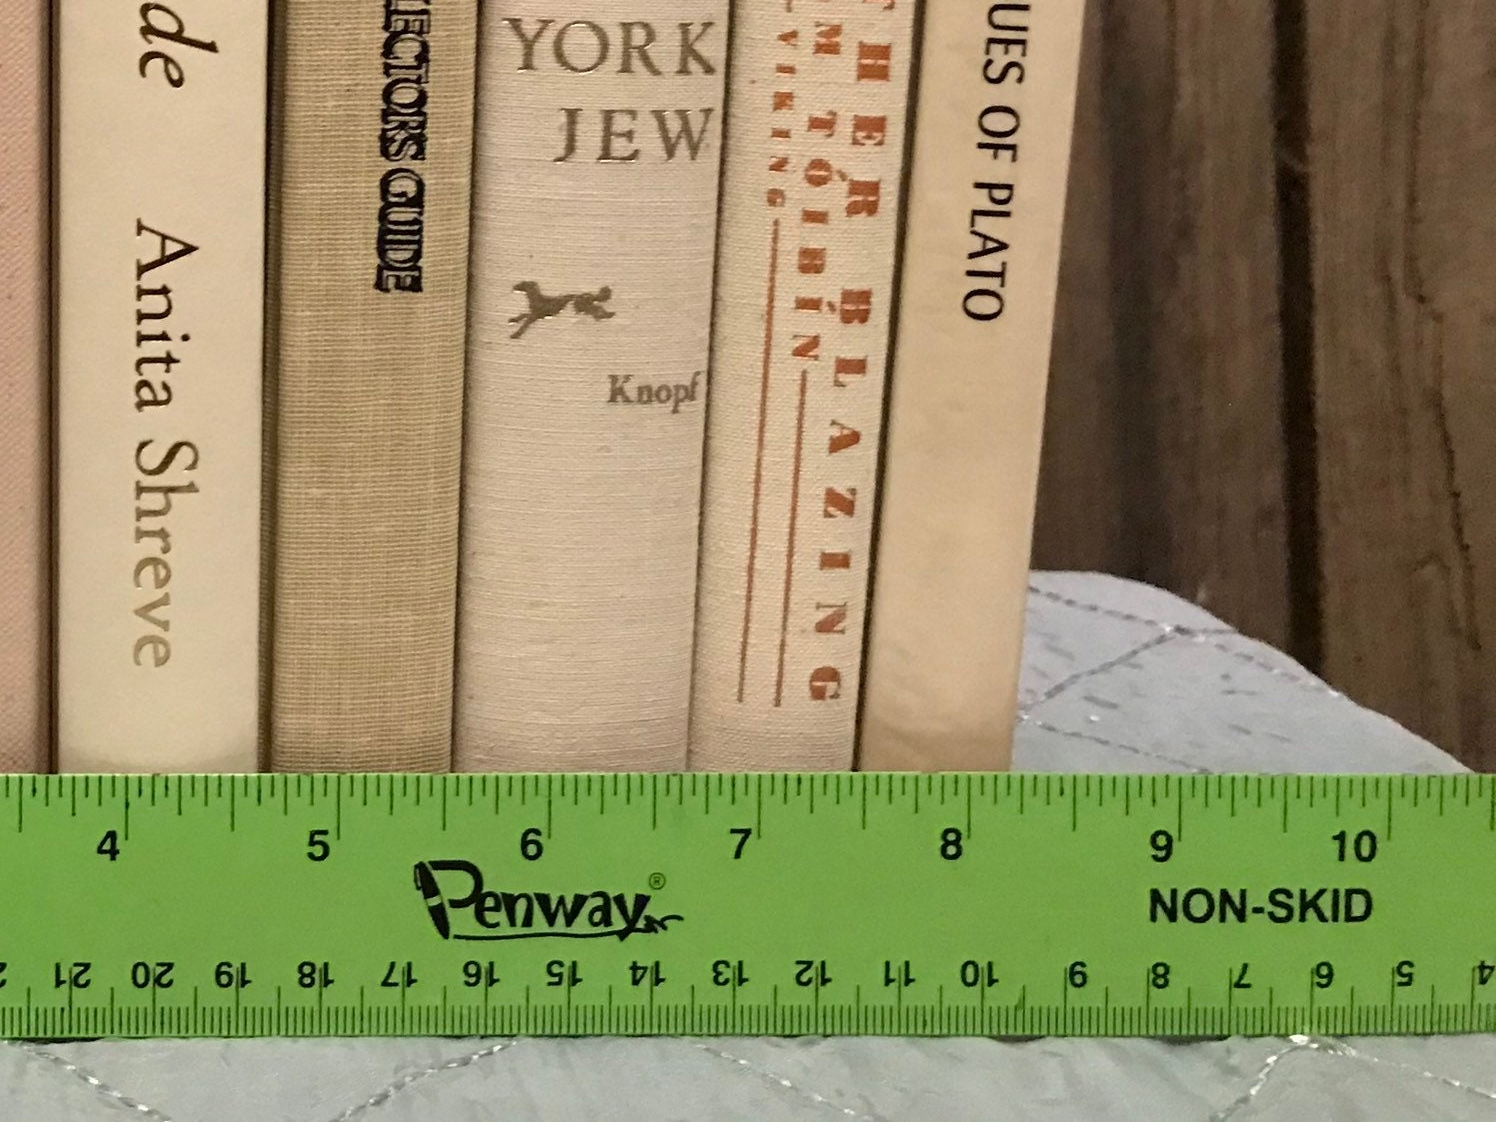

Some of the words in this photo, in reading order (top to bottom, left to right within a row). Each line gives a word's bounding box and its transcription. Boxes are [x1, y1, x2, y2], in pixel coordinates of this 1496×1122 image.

[503, 19, 717, 77] YORK
[765, 29, 799, 208] VIKING
[553, 108, 714, 164] JEW
[973, 104, 1021, 164] OF
[374, 168, 427, 293] GUIDE
[961, 182, 1015, 323] PLATO
[135, 217, 199, 413] Anita
[607, 371, 702, 414] Knopf
[808, 287, 874, 702] BLAZING
[133, 439, 199, 669] Shreve
[96, 830, 120, 862] 4
[306, 830, 331, 862] 5
[519, 828, 544, 860] 6
[729, 828, 751, 859] 7
[940, 828, 963, 860] 8
[1149, 830, 1173, 863] 9
[1332, 831, 1378, 863] 10
[1149, 888, 1374, 924] NON-SKID
[54, 961, 91, 988] 21
[131, 961, 174, 988] 20
[214, 961, 252, 988] 19
[298, 961, 334, 988] 18
[380, 961, 417, 988] 17
[462, 961, 500, 988] 16
[545, 960, 582, 987] 15
[628, 960, 665, 987] 14
[711, 959, 749, 987] 13
[794, 959, 832, 987] 12
[882, 960, 916, 987] 11
[960, 960, 999, 987] 10
[1068, 961, 1089, 988] 9
[1151, 961, 1171, 988] 8
[1233, 961, 1253, 988] 7
[1314, 961, 1334, 988] 6
[1395, 959, 1414, 987] 5
[1477, 960, 1495, 985] 4
